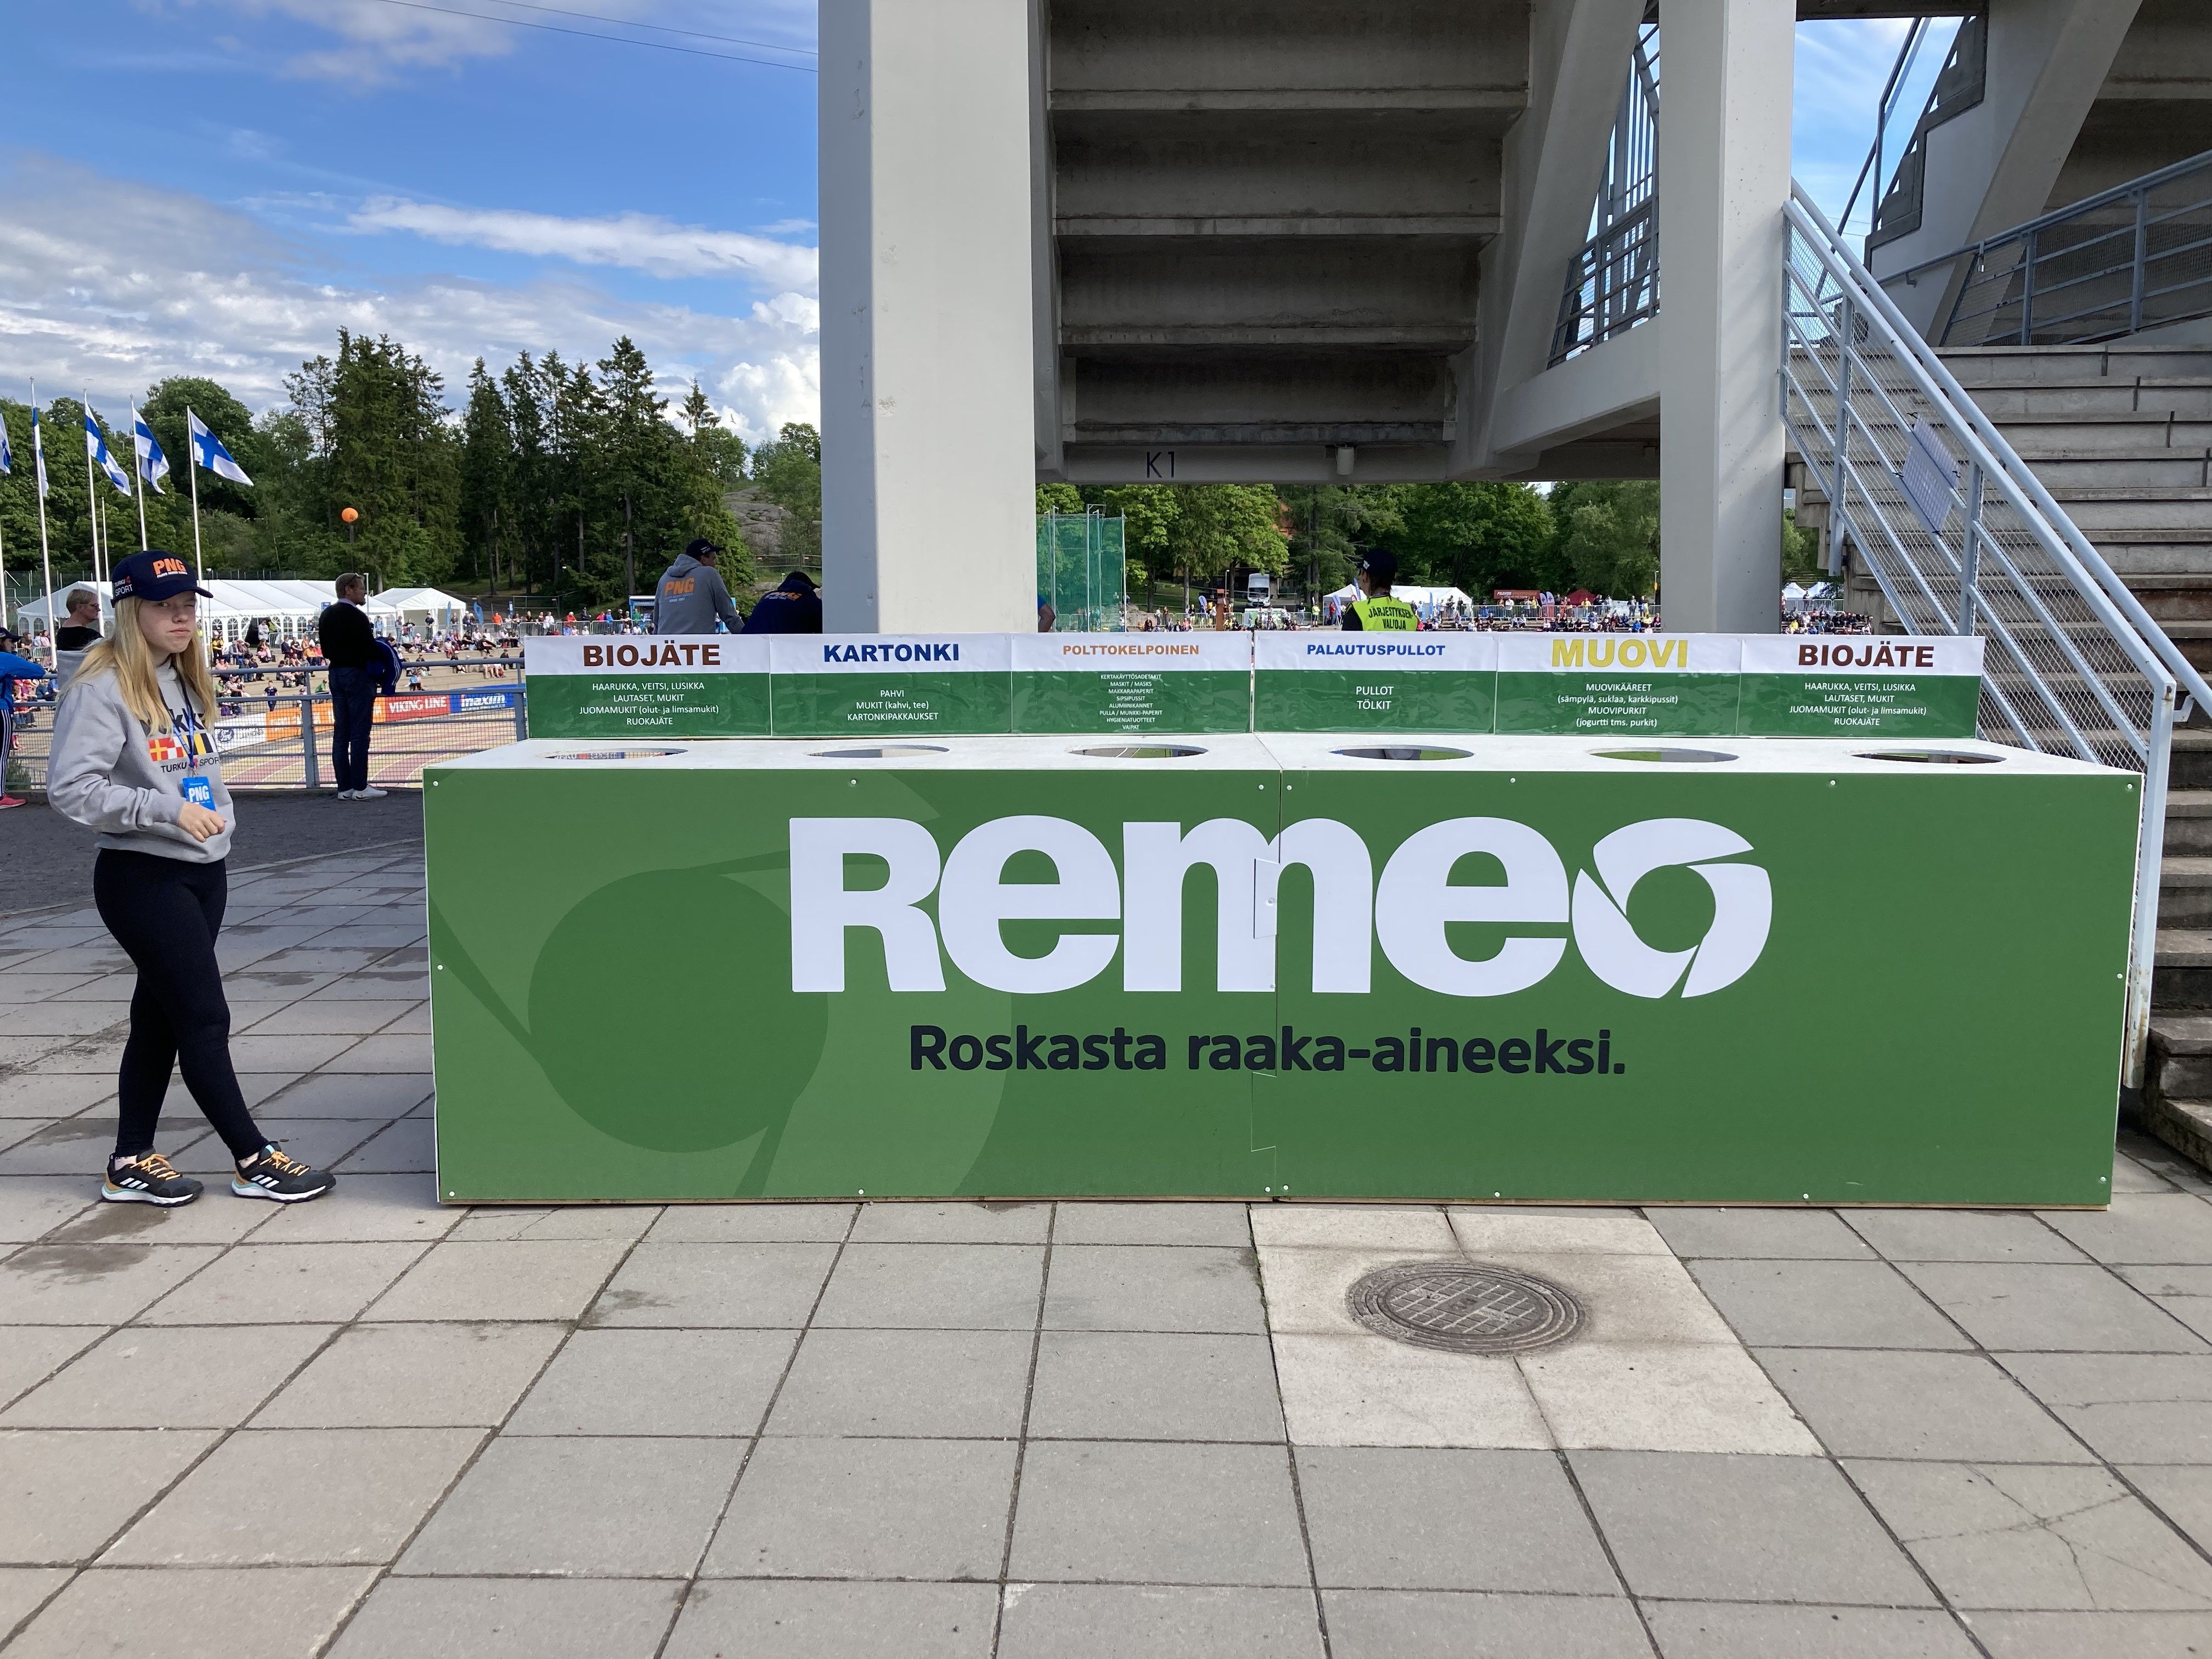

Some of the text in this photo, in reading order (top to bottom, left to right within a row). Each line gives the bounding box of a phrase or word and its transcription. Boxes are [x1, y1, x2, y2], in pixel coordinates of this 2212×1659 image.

[1146, 451, 1175, 478] K1
[153, 558, 187, 575] PNG
[115, 584, 133, 596] SPORT
[664, 577, 695, 597] PNG
[583, 640, 720, 667] BIOJÄTE
[823, 644, 960, 663] KARTONKI
[1063, 645, 1200, 655] POLTTOKELPOINEN
[1307, 644, 1446, 656] PALAUTUSPULLOT
[1551, 639, 1688, 668] MUOVI
[1798, 640, 1934, 667] BIOJÄTE
[592, 682, 705, 692] HAARUKKA, VEITSI, LUSIKKA
[1356, 686, 1394, 696] PULLOT
[1586, 682, 1652, 692] MUOVIKÄÄREET
[1805, 682, 1916, 693] HAARUKKA, VEITSI, LUSIKKA
[613, 693, 685, 703] LAUTASET, MUKIT
[880, 690, 905, 698] PAHVI
[1558, 695, 1678, 704] (sämpylä, suklaa, karkkipussit)
[1824, 694, 1895, 704] LAUTASET, MUKIT
[388, 700, 424, 713] VIKING
[425, 696, 447, 709] LINE
[579, 704, 719, 715] JUOMAMUKIT (olut- ja limsamukit)
[856, 701, 929, 710] MUKIT (kahvi, tee)
[1357, 699, 1392, 710] TÖLKIT
[1588, 706, 1647, 715] MUOVIPURKIT
[1789, 706, 1927, 716] JUOMAMUKIT (olut- ja limsamukit)
[626, 716, 674, 726] RUOKAJÄTE
[847, 712, 939, 721] KARTONKIPAKKAUKSET
[1834, 717, 1881, 726] RUOKAJÄTE
[1576, 718, 1657, 728] (jogurtti tms. purkit)
[160, 761, 187, 774] TURKU
[199, 757, 219, 767] SPOR
[188, 785, 210, 803] PNG
[790, 814, 1772, 998] Remeo
[910, 1025, 1626, 1075] Roskasta raaka-aineeksi.
